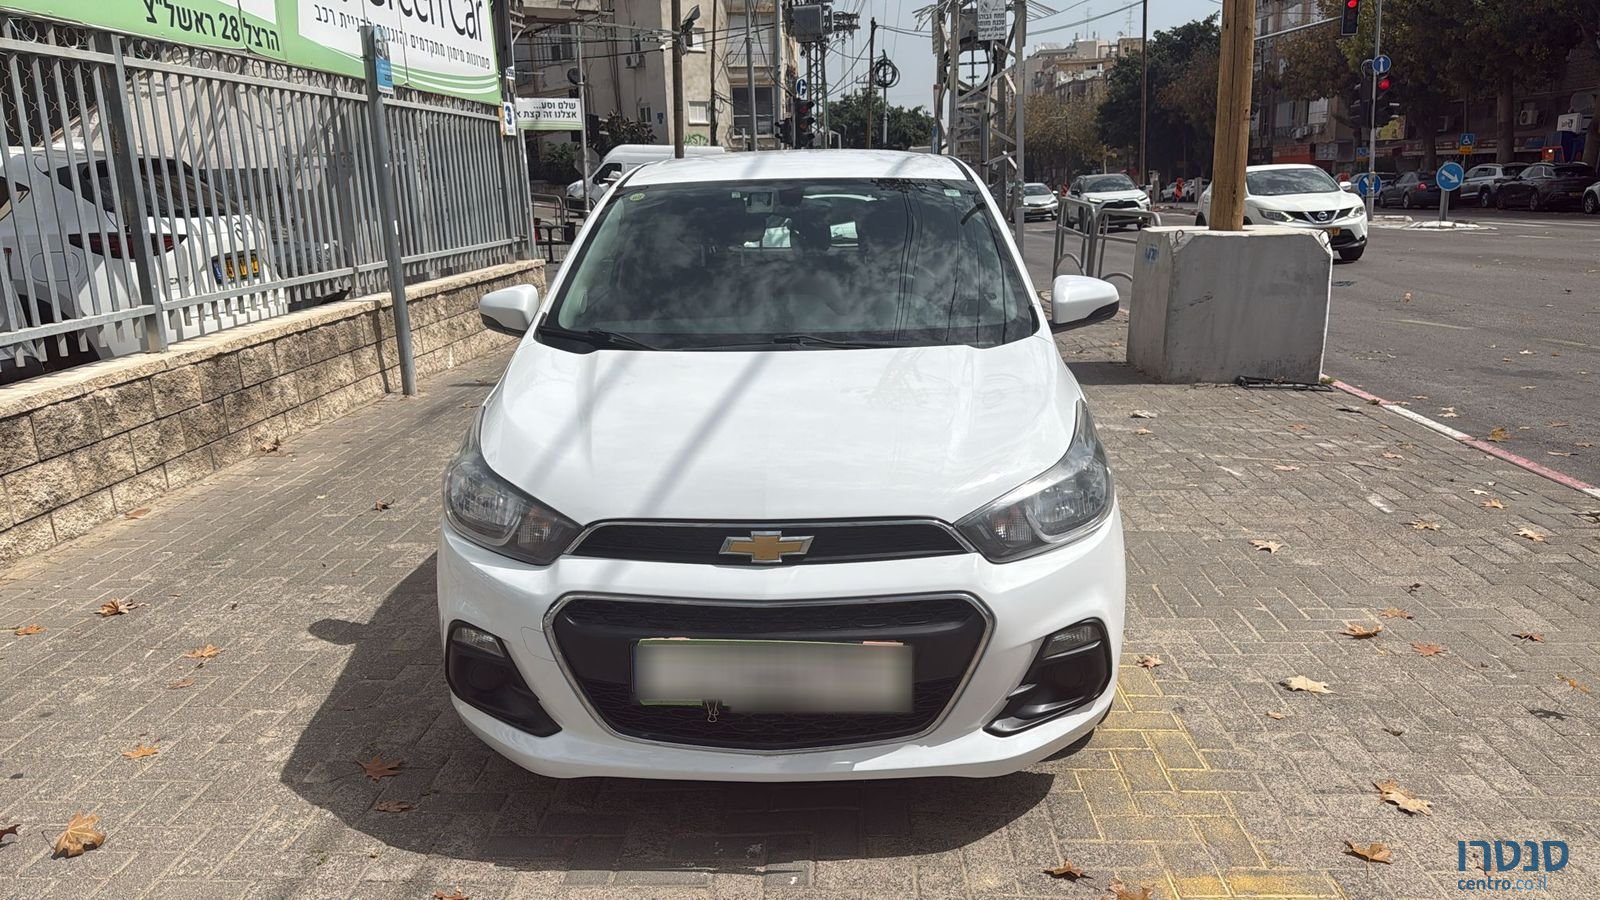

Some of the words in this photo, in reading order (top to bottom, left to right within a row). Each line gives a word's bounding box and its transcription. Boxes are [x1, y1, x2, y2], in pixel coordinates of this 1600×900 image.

[314, 4, 337, 26] רכב
[218, 12, 241, 42] 28
[242, 18, 281, 51] הרצל
[558, 101, 576, 109] שלם
[523, 111, 541, 119] קצת
[554, 110, 577, 118] אצלנו
